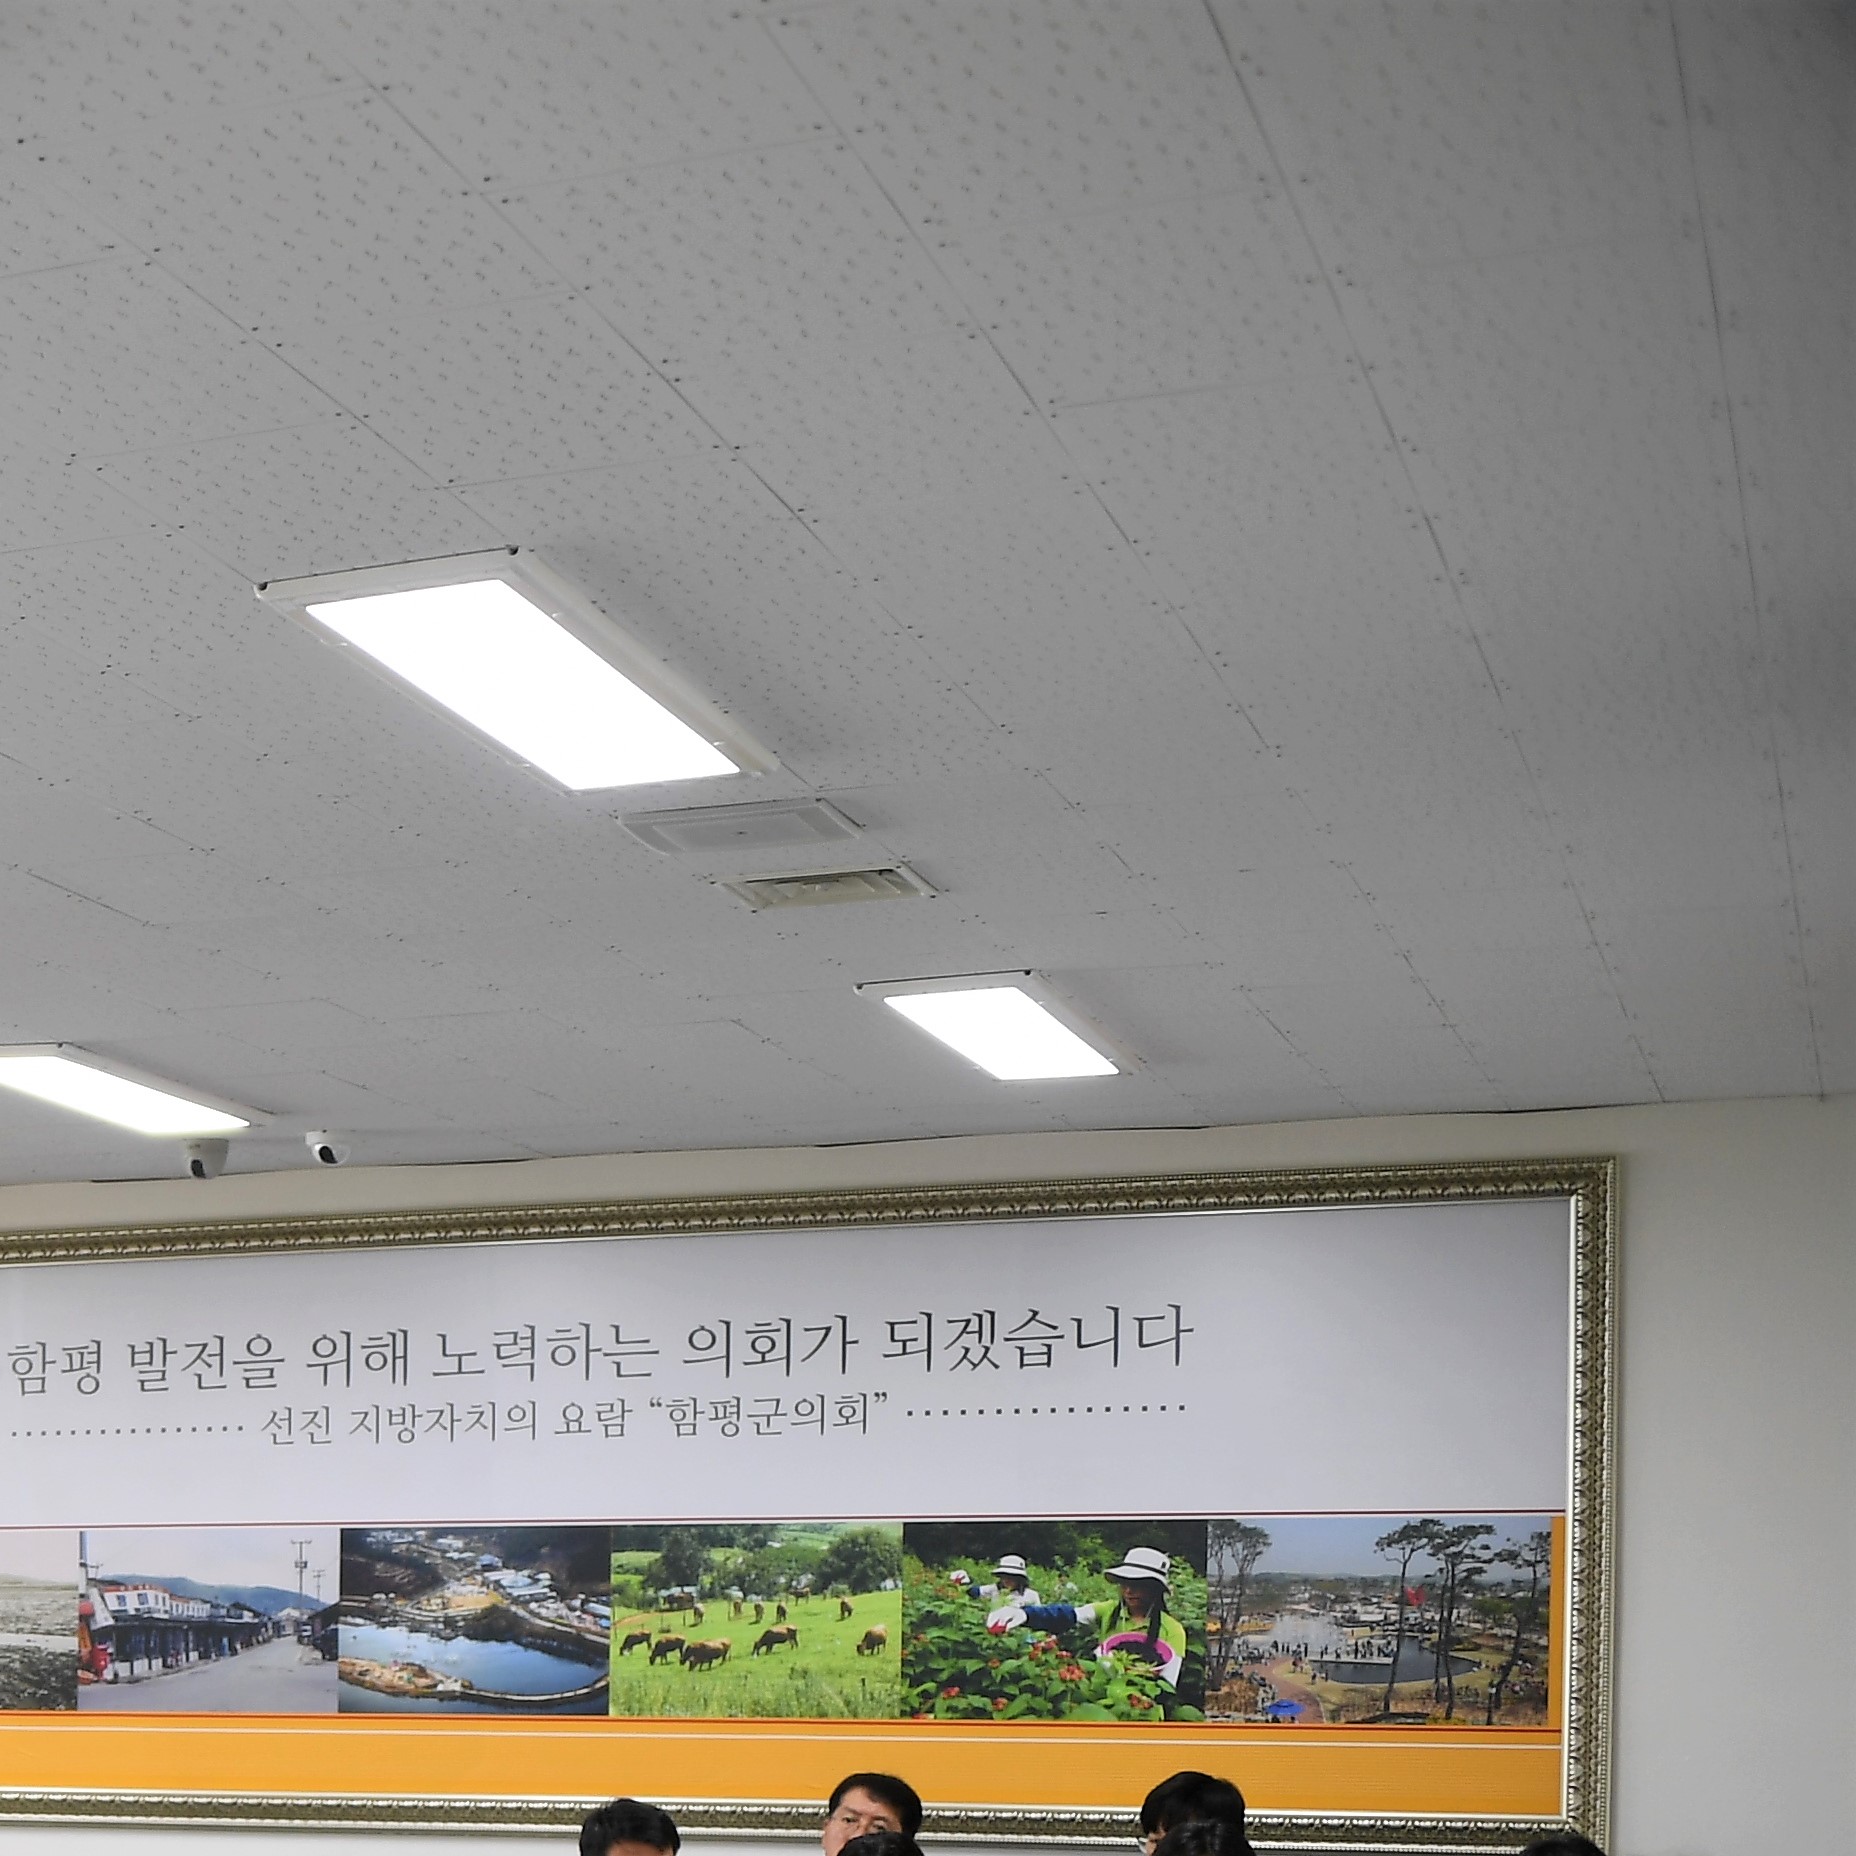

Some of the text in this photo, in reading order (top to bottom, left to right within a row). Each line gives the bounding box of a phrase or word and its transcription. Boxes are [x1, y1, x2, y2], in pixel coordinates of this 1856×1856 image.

[7, 1304, 1194, 1396] 함평 발전을 위해 노력하는 의회가 되겠습니다
[261, 1406, 332, 1445] 선진
[349, 1400, 536, 1444] 지방자치의
[554, 1398, 633, 1438] 요람
